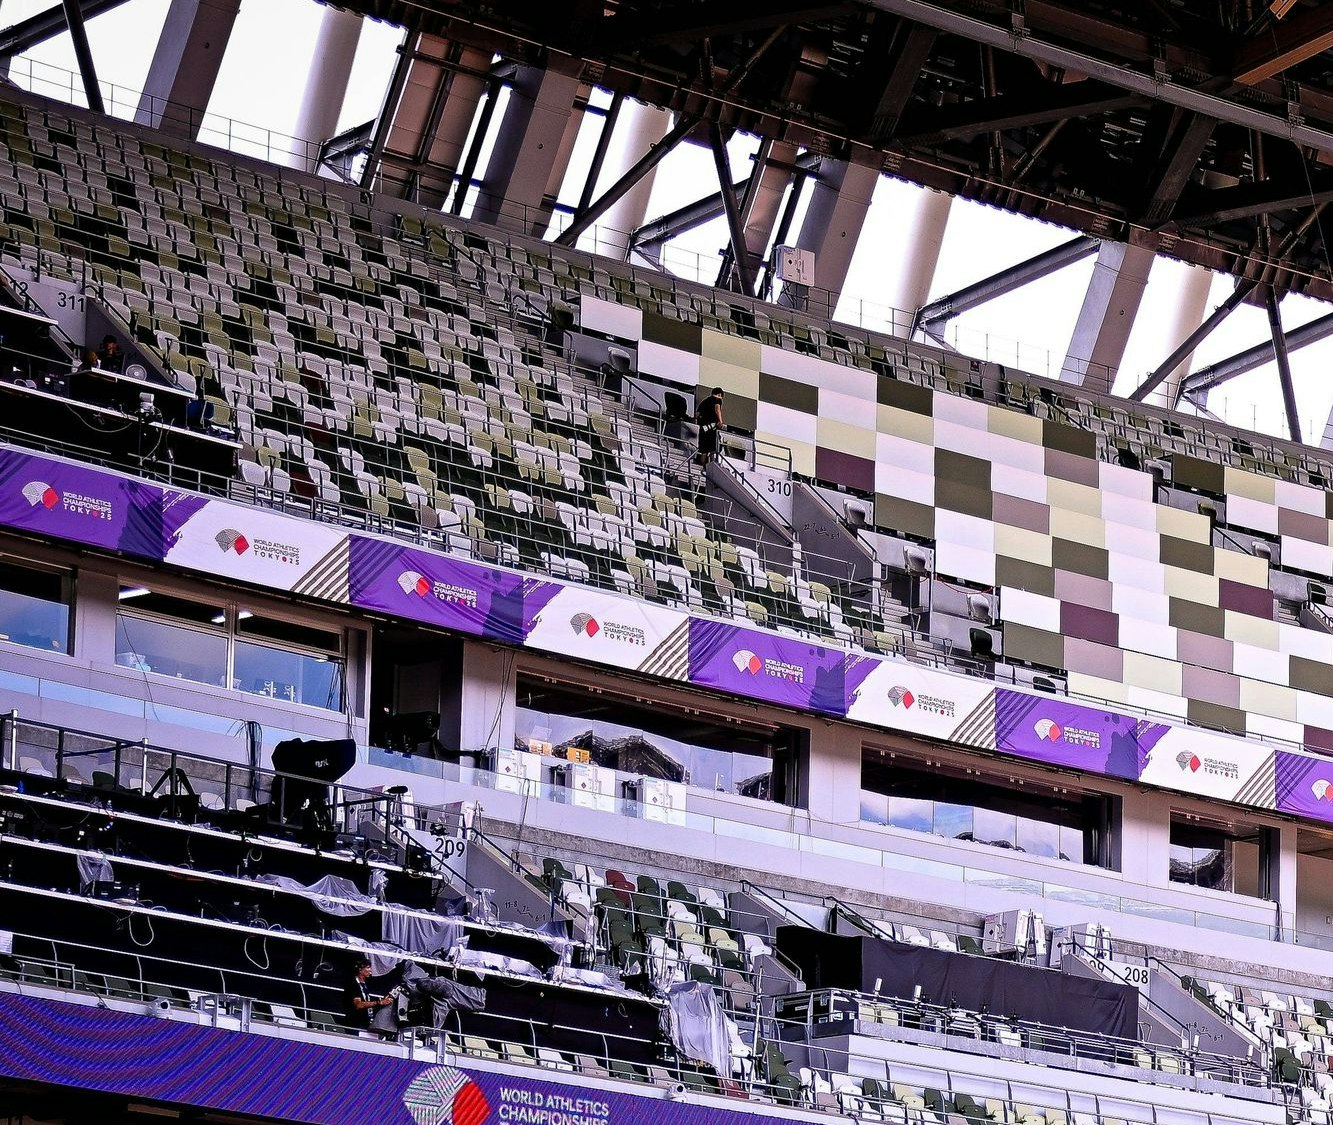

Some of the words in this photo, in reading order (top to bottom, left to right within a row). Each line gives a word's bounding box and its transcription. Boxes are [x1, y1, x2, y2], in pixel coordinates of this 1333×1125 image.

[57, 291, 86, 312] 311
[768, 478, 791, 497] 310
[435, 837, 466, 857] 209
[1124, 967, 1149, 984] 208
[500, 1088, 543, 1106] WORLD
[546, 1097, 609, 1116] ATHLETICS
